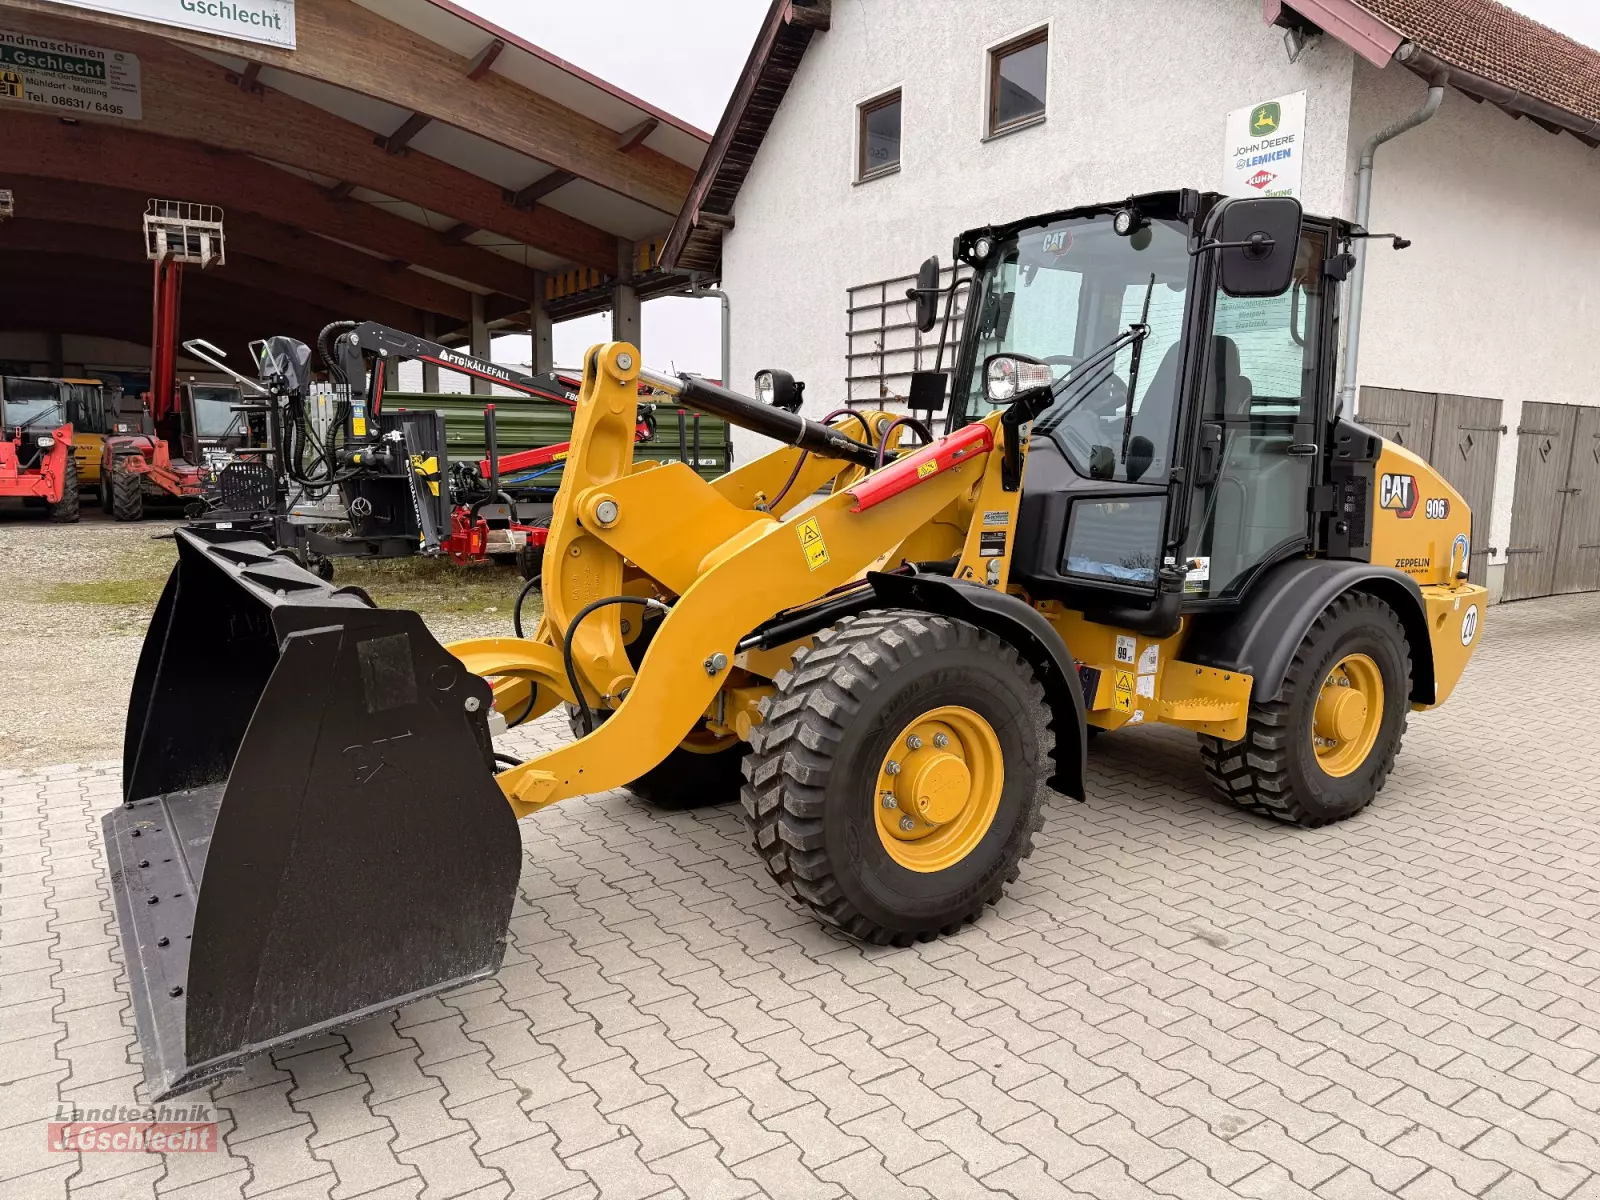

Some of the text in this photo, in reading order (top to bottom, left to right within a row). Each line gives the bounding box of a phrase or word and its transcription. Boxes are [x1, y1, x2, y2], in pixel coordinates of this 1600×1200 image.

[180, 0, 281, 30] Gschlecht
[0, 34, 104, 60] andmaschinen
[13, 51, 102, 76] Gschlecht
[26, 91, 47, 103] Tel.
[95, 102, 123, 115] 6495
[1233, 134, 1295, 157] JOHN DEERE
[1245, 148, 1291, 168] LEMKEN
[1249, 173, 1274, 185] KUHN
[1042, 231, 1067, 253] CAT
[1380, 475, 1411, 508] CAT
[1426, 499, 1446, 519] 906
[1395, 558, 1430, 568] ZEPPELIN
[1463, 612, 1476, 639] 20
[1117, 646, 1127, 660] 99
